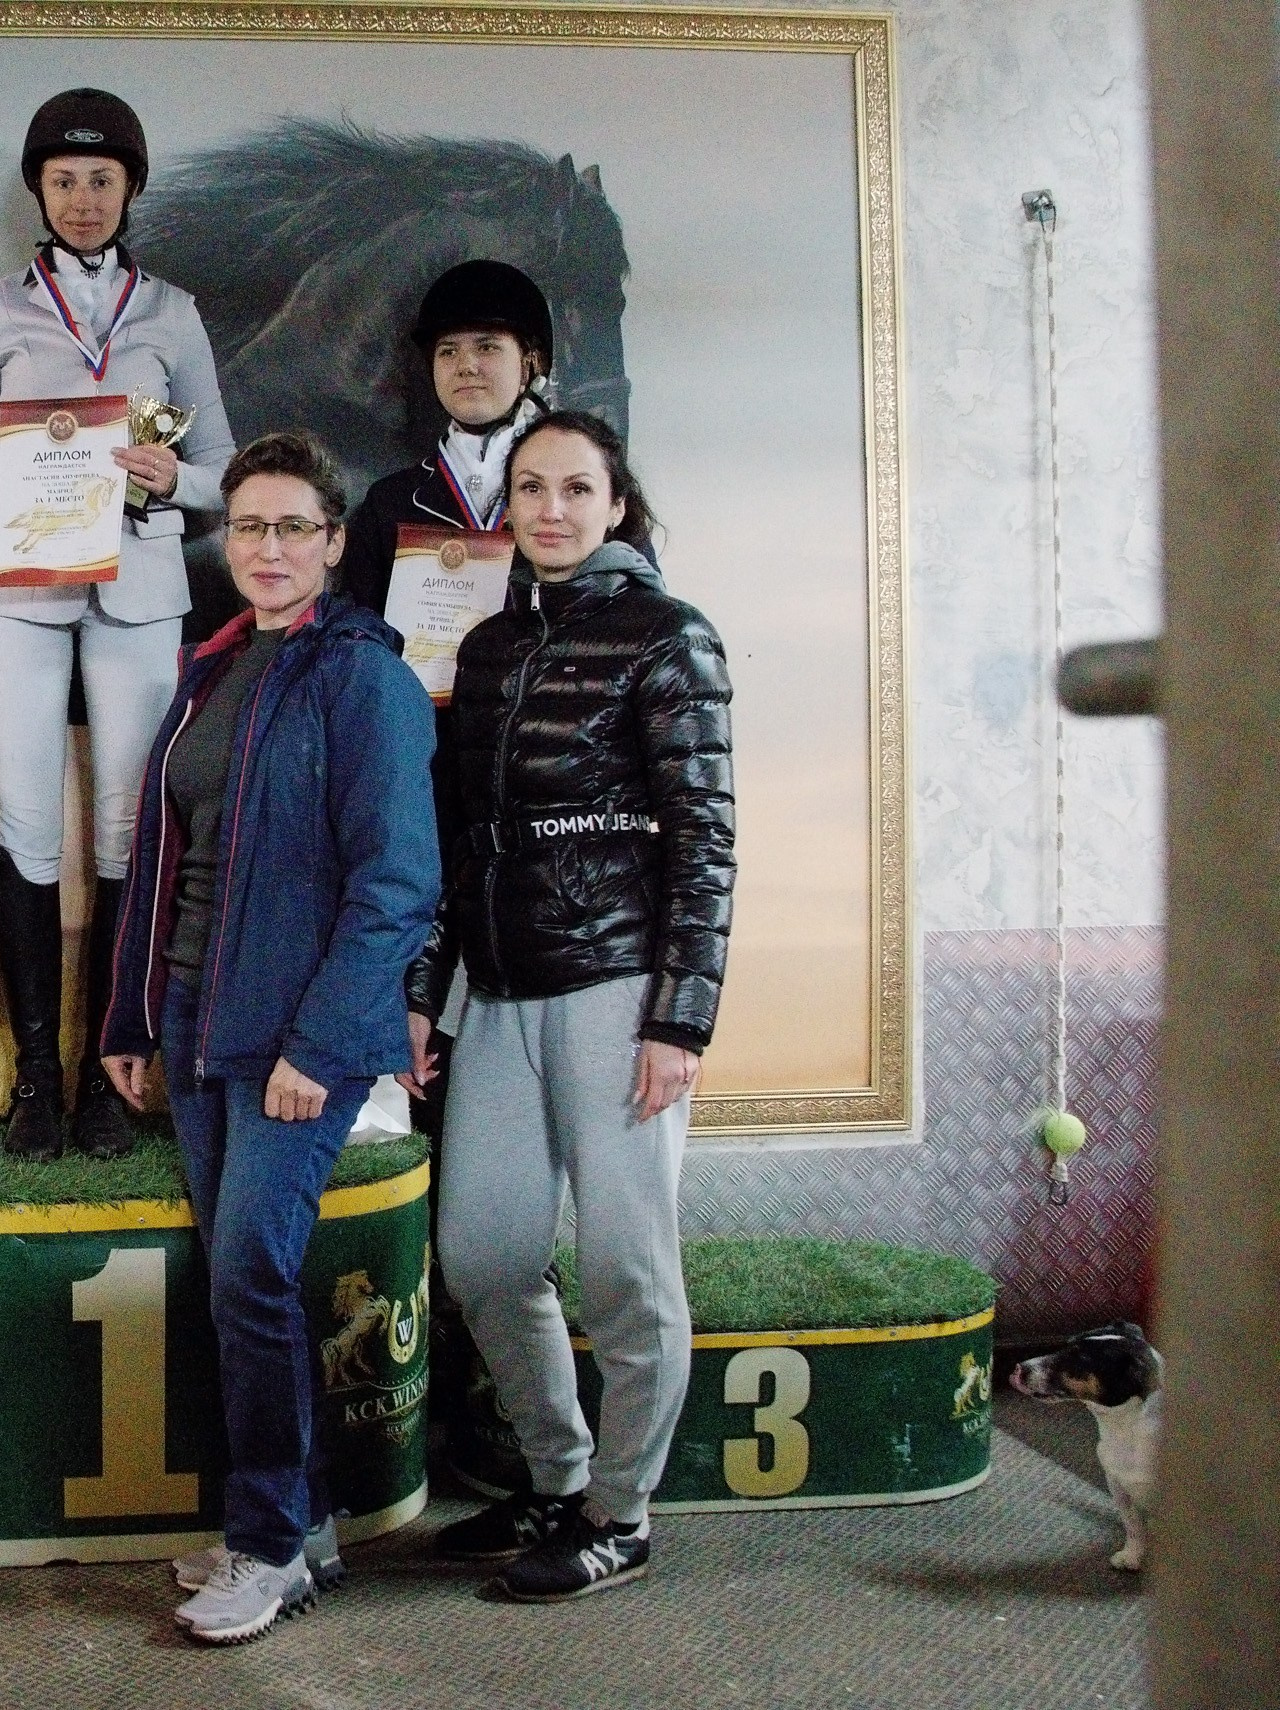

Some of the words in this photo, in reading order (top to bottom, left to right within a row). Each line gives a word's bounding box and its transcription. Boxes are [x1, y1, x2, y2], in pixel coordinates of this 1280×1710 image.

[33, 450, 91, 463] ДИПЛОМ
[422, 577, 474, 591] ДИПЛОМ
[439, 625, 465, 633] МЕСТО
[531, 813, 607, 838] TOMMY
[64, 1248, 200, 1518] 1
[723, 1347, 811, 1498] 3
